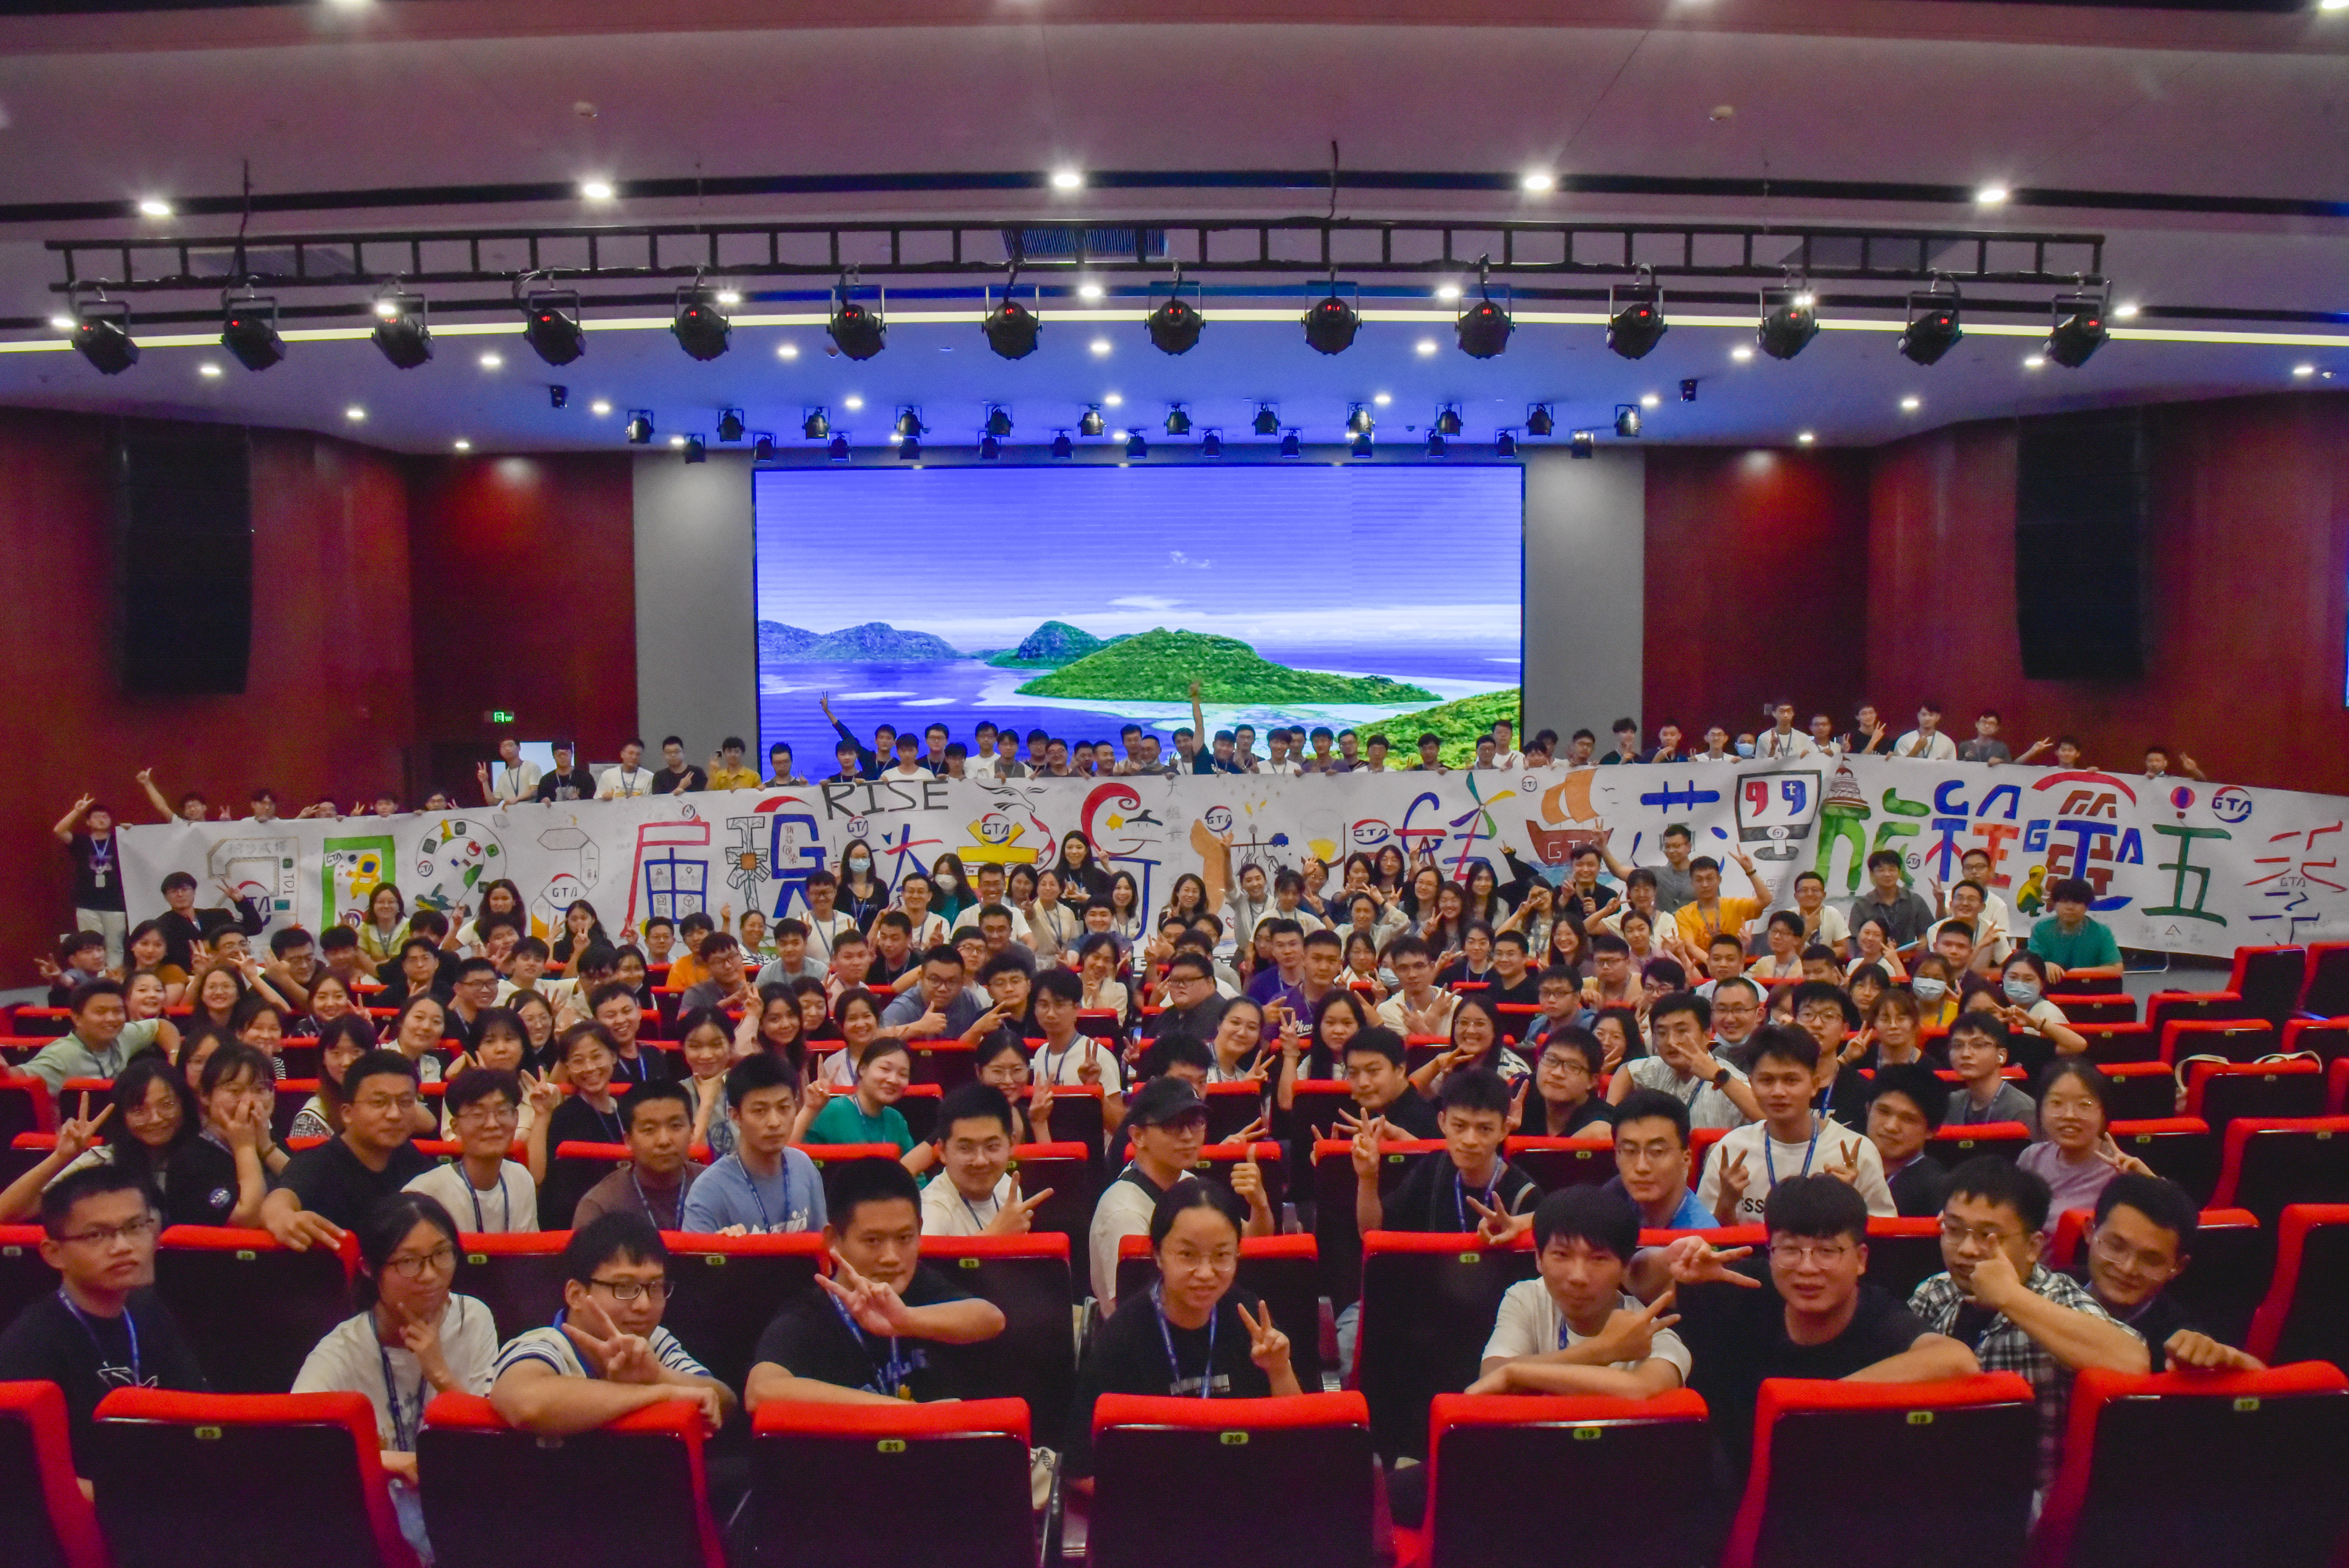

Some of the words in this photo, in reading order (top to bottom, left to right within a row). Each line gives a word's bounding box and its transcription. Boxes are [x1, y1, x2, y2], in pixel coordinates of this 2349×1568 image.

[822, 780, 948, 820] RISE
[2212, 797, 2252, 814] GTA
[1207, 815, 1232, 824] GTA
[847, 821, 868, 833] GTA
[981, 824, 1009, 835] GTA
[2281, 877, 2306, 887] GTA
[552, 887, 577, 897] GTA
[211, 1190, 228, 1203] NASA
